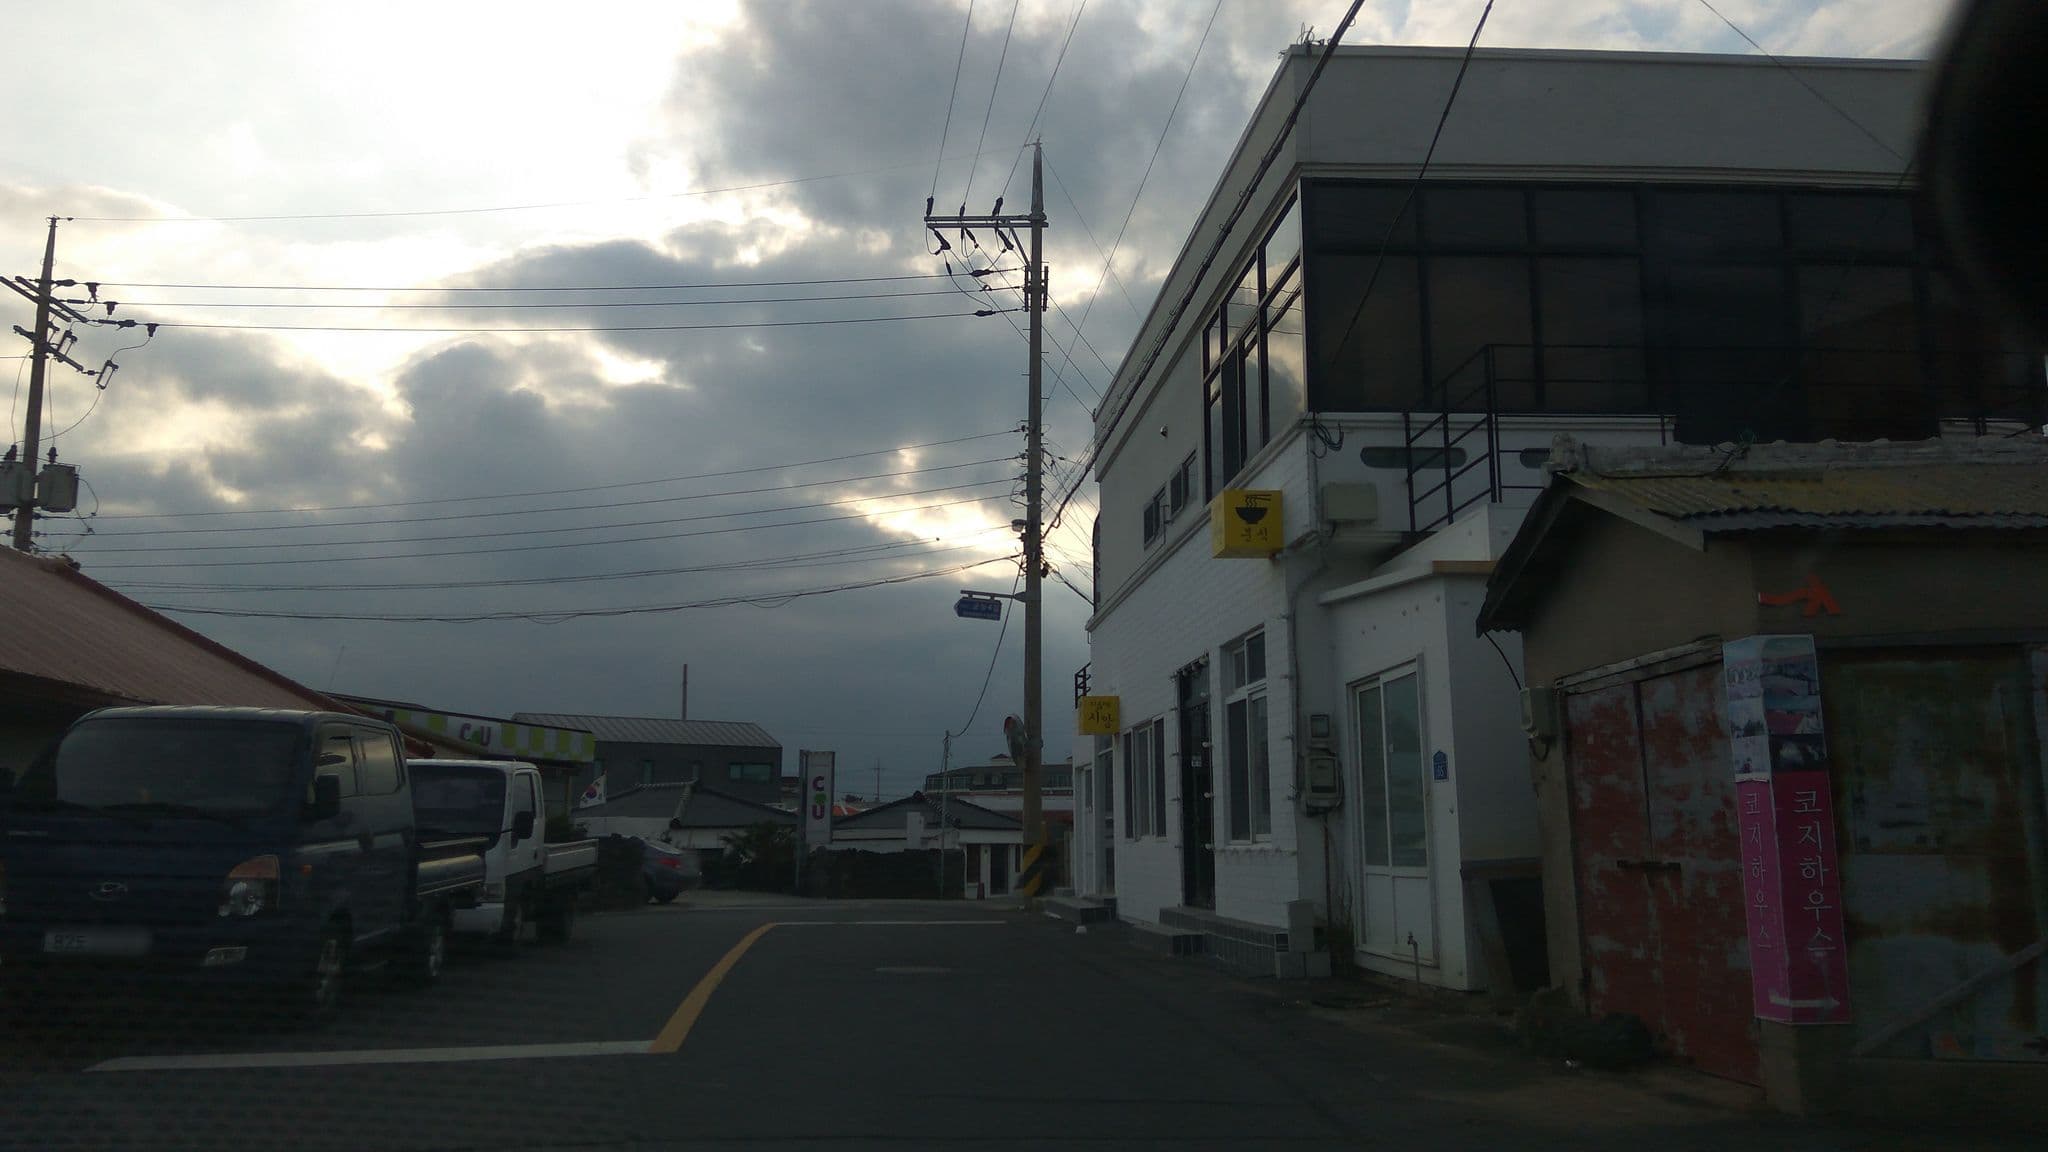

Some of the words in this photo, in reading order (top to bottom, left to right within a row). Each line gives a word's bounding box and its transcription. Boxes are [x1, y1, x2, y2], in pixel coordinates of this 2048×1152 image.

[460, 722, 490, 746] CU
[1745, 792, 1772, 948] 코지하우스
[1792, 790, 1836, 951] 코지하우스
